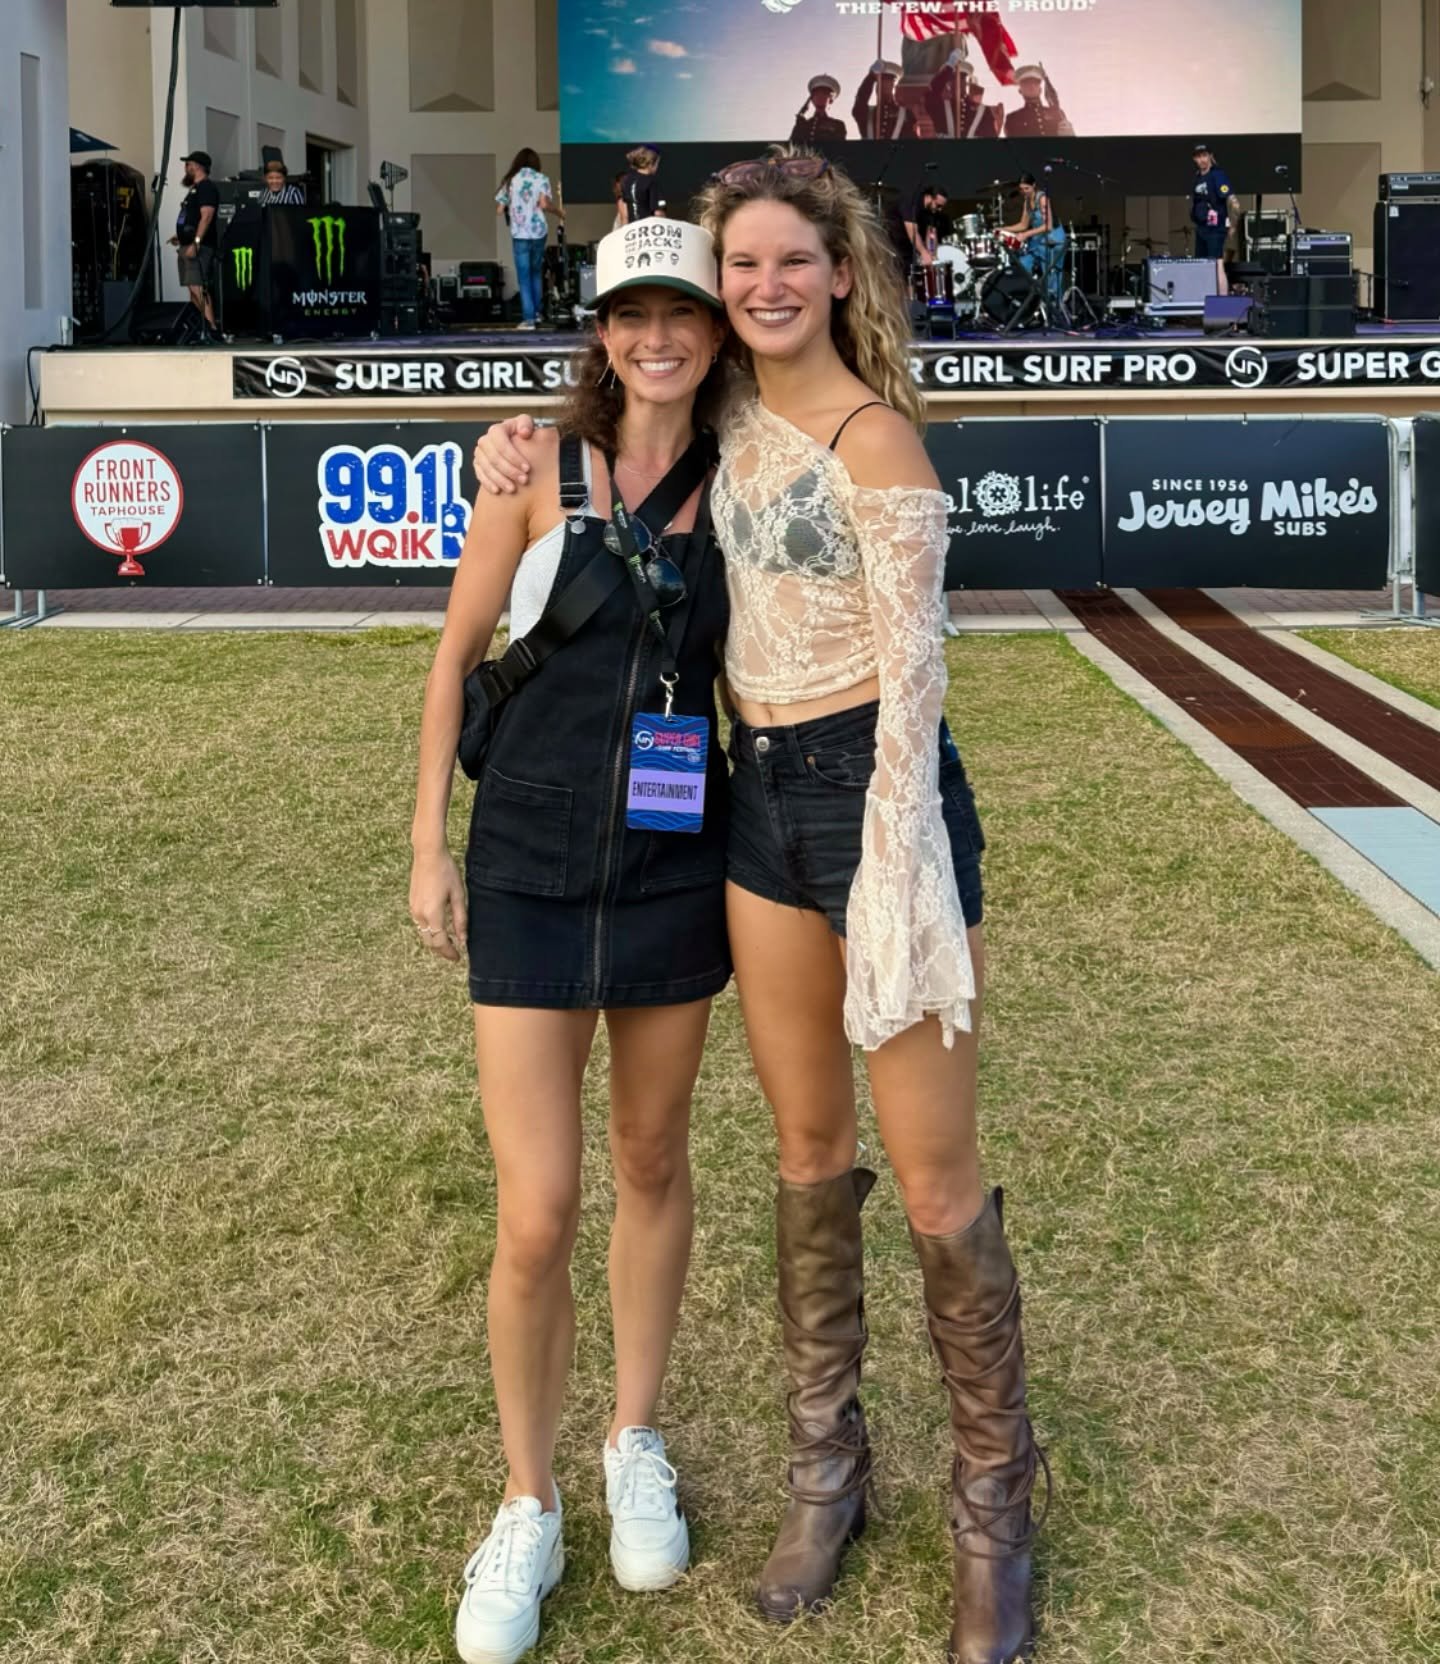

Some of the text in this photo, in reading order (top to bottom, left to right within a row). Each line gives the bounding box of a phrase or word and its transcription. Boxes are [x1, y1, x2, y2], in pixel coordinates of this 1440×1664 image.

[836, 1, 882, 15] THE
[953, 1, 1000, 13] THE
[624, 223, 683, 242] GROM
[638, 236, 682, 250] JACKS
[292, 288, 368, 307] MONSTER
[304, 307, 357, 317] ENERGY
[335, 361, 446, 391] SUPER
[455, 360, 533, 389] GIRL
[934, 355, 1014, 384] GIRL
[1022, 354, 1113, 383] SURF
[1123, 353, 1198, 383] PRO
[1297, 351, 1411, 380] SUPER
[95, 458, 157, 480] FRONT
[83, 480, 171, 504] RUNNERS
[324, 451, 437, 524] 99.1
[1151, 478, 1249, 492] SINCE 1956
[90, 505, 166, 516] TAPHOUSE
[1117, 477, 1378, 535] Jersey Mike's
[1273, 521, 1327, 536] SUBS
[325, 528, 437, 561] WQIK
[632, 781, 699, 801] ENTERTAINMENT
